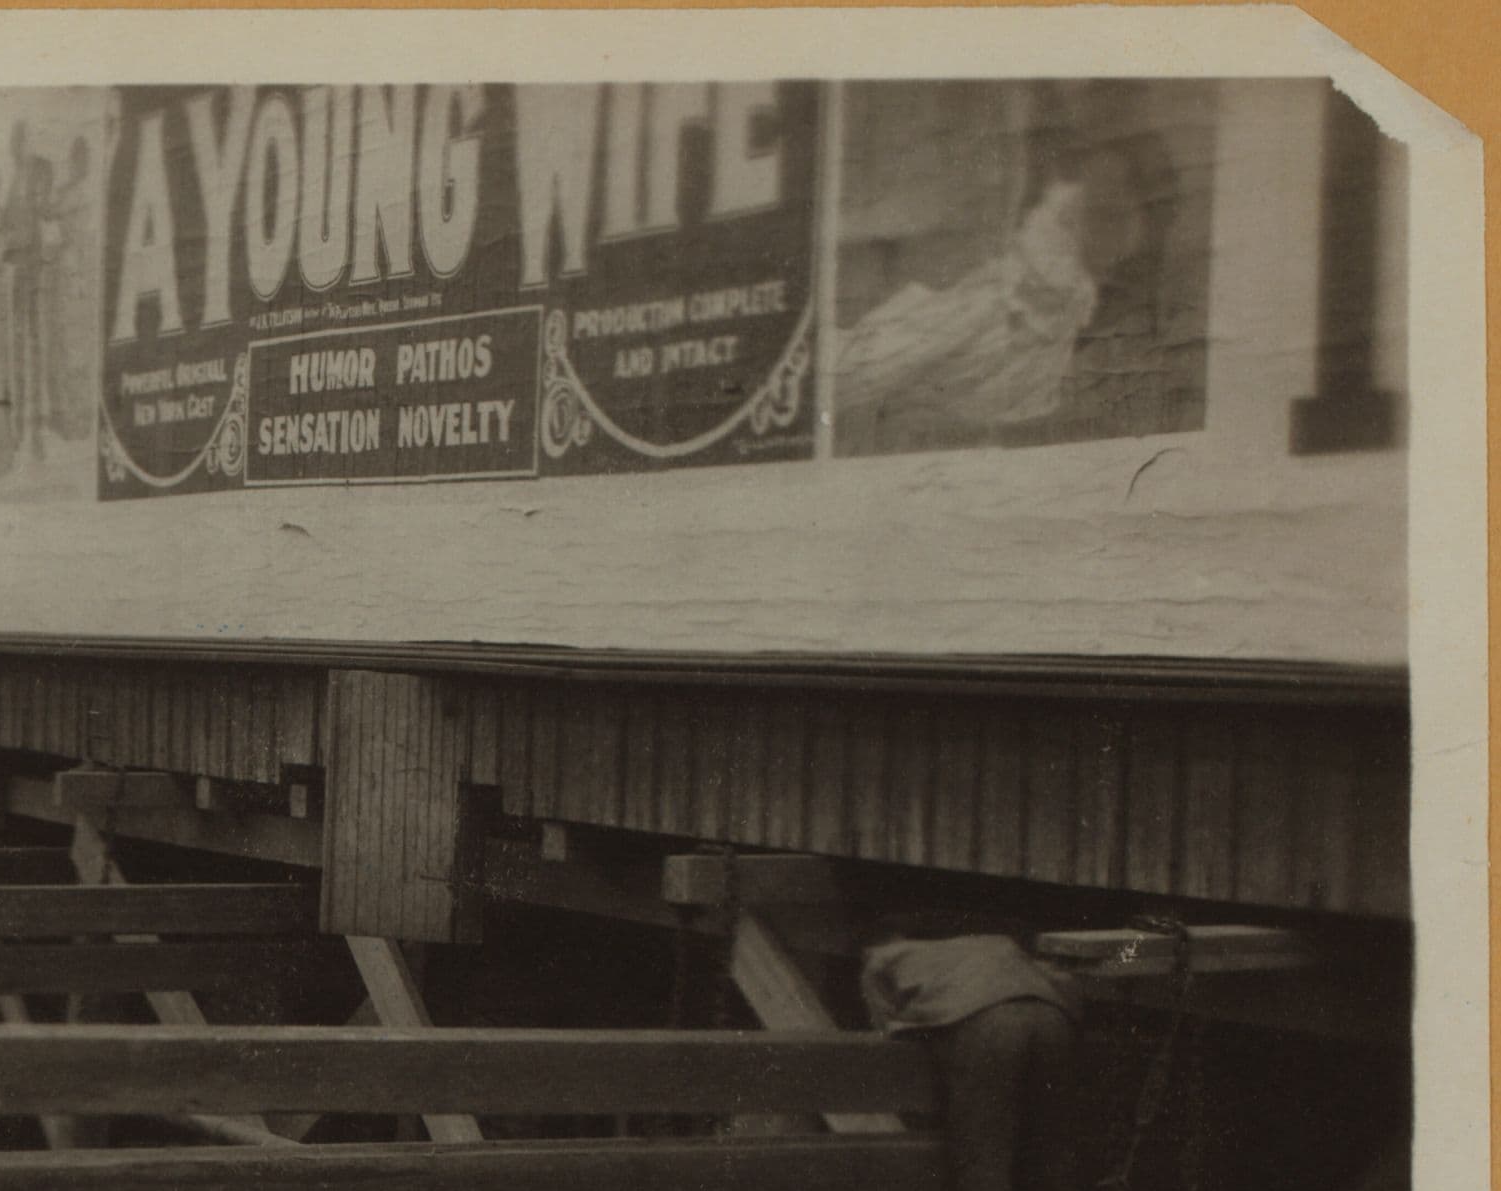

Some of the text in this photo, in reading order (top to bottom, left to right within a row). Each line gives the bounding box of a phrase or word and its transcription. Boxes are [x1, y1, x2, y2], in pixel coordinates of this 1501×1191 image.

[107, 104, 186, 346] A
[183, 84, 484, 330] YOUNG
[289, 335, 492, 394] HUMOR PATHOS
[258, 399, 515, 456] SENSATION NOVELTY
